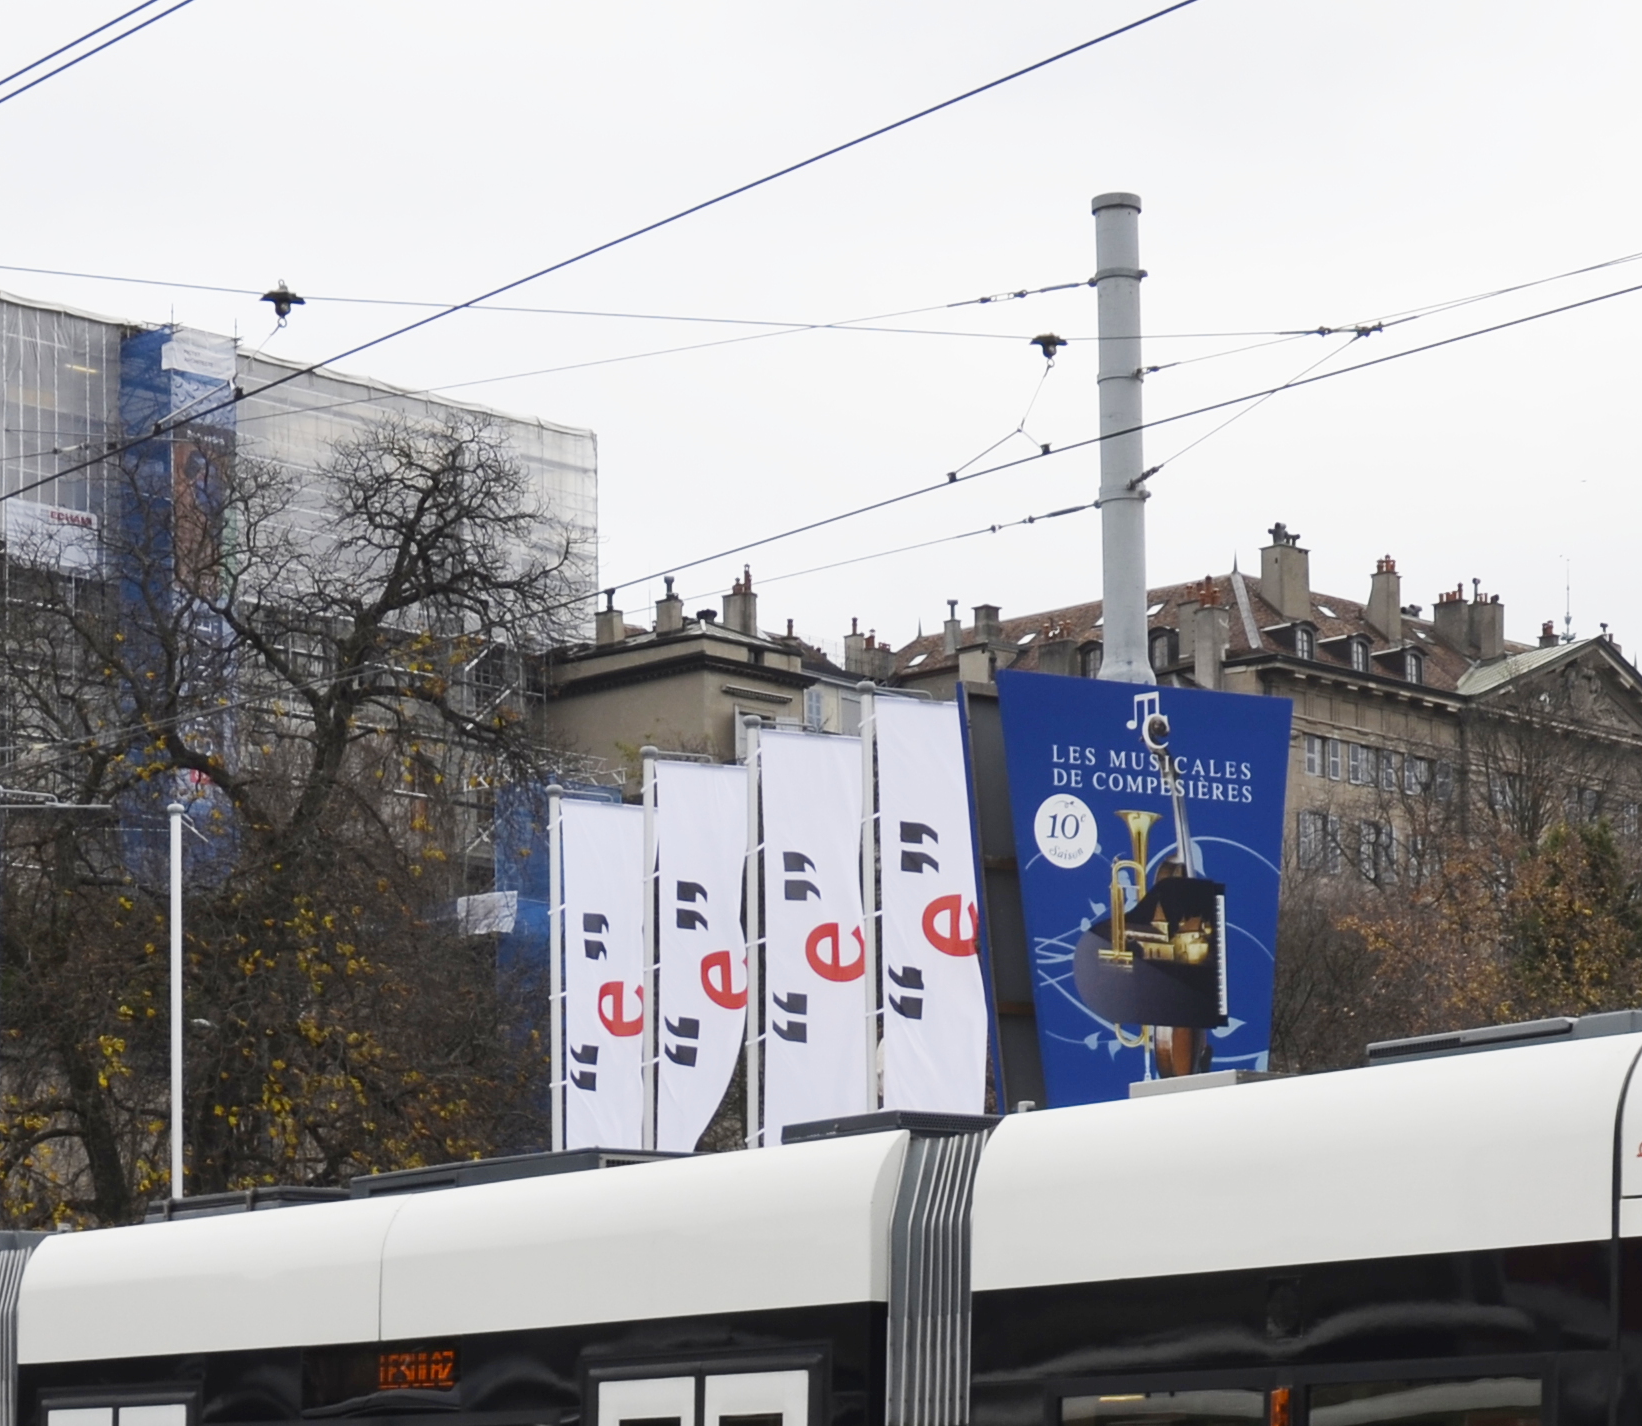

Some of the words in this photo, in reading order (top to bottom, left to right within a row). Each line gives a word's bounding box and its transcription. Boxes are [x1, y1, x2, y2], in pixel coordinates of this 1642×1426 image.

[1052, 745, 1095, 765] LES
[1109, 751, 1252, 780] MUSICALES
[1052, 768, 1083, 788] DE
[1093, 771, 1252, 803] COMPESIÈRES
[1048, 844, 1084, 861] Saison
